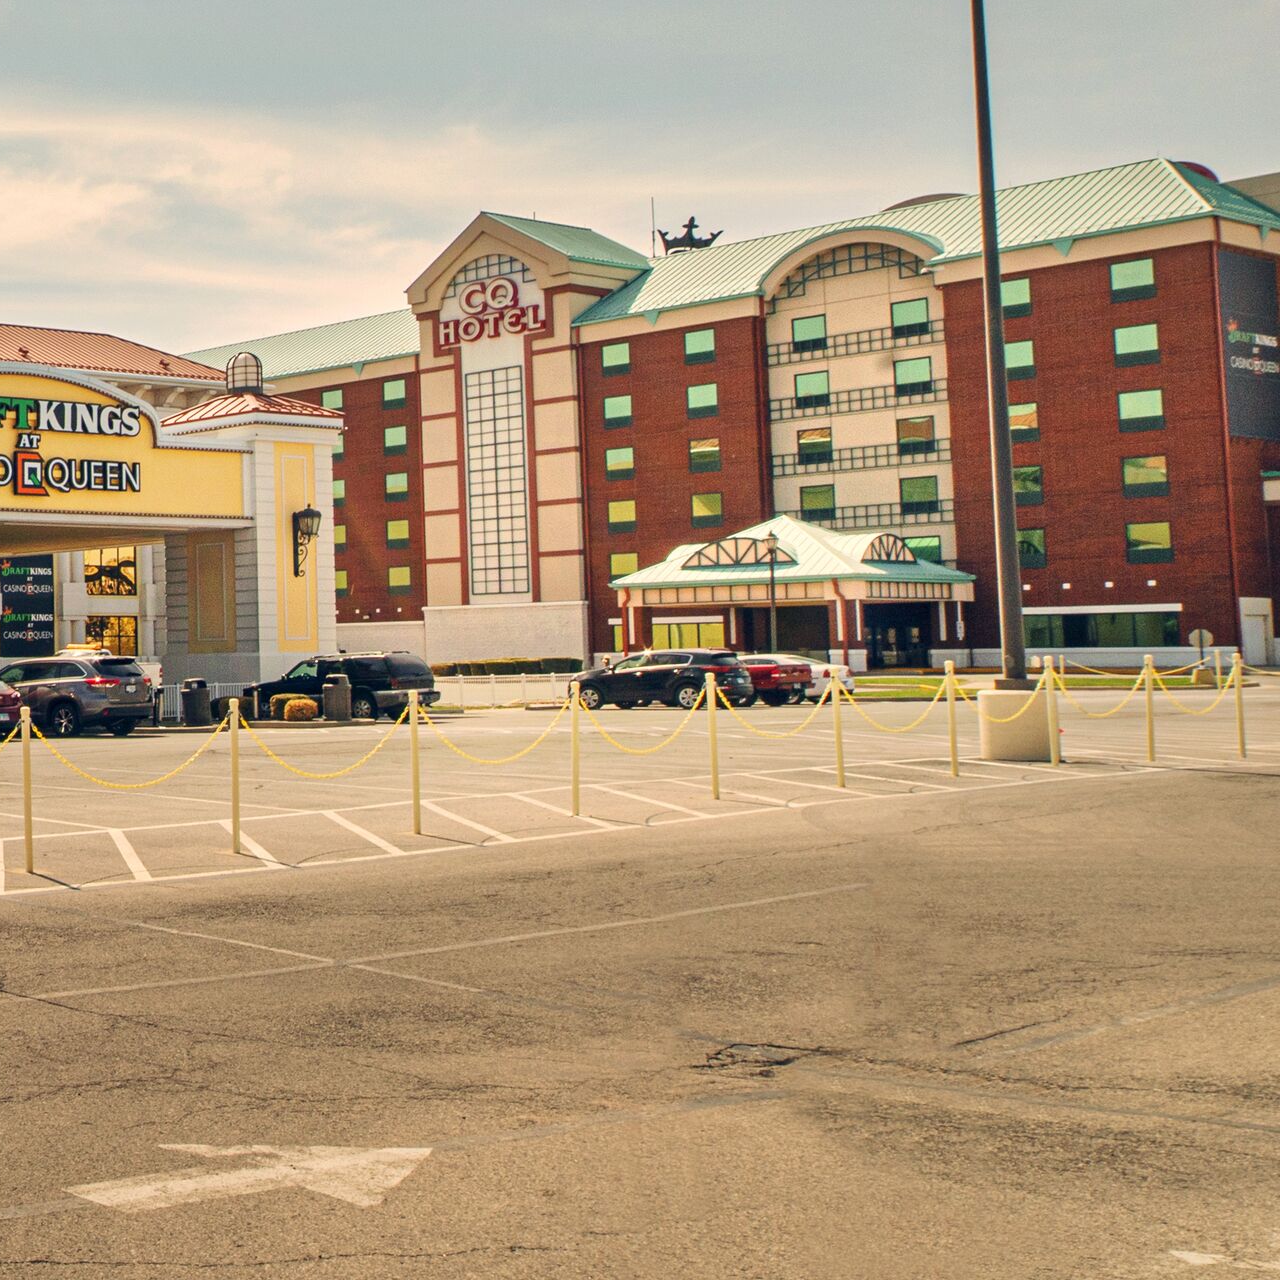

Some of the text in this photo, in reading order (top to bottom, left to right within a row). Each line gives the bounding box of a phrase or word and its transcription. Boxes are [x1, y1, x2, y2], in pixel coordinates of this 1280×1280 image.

[459, 277, 519, 315] CQ
[439, 304, 545, 346] HOTEL
[16, 433, 41, 449] AT
[45, 458, 141, 493] QUEEN
[2, 567, 52, 576] DRAFTKINGS
[3, 584, 53, 593] CASINO QUEEN
[3, 613, 53, 623] DRAFTKINGS
[3, 630, 53, 640] CASINO QUEEN
